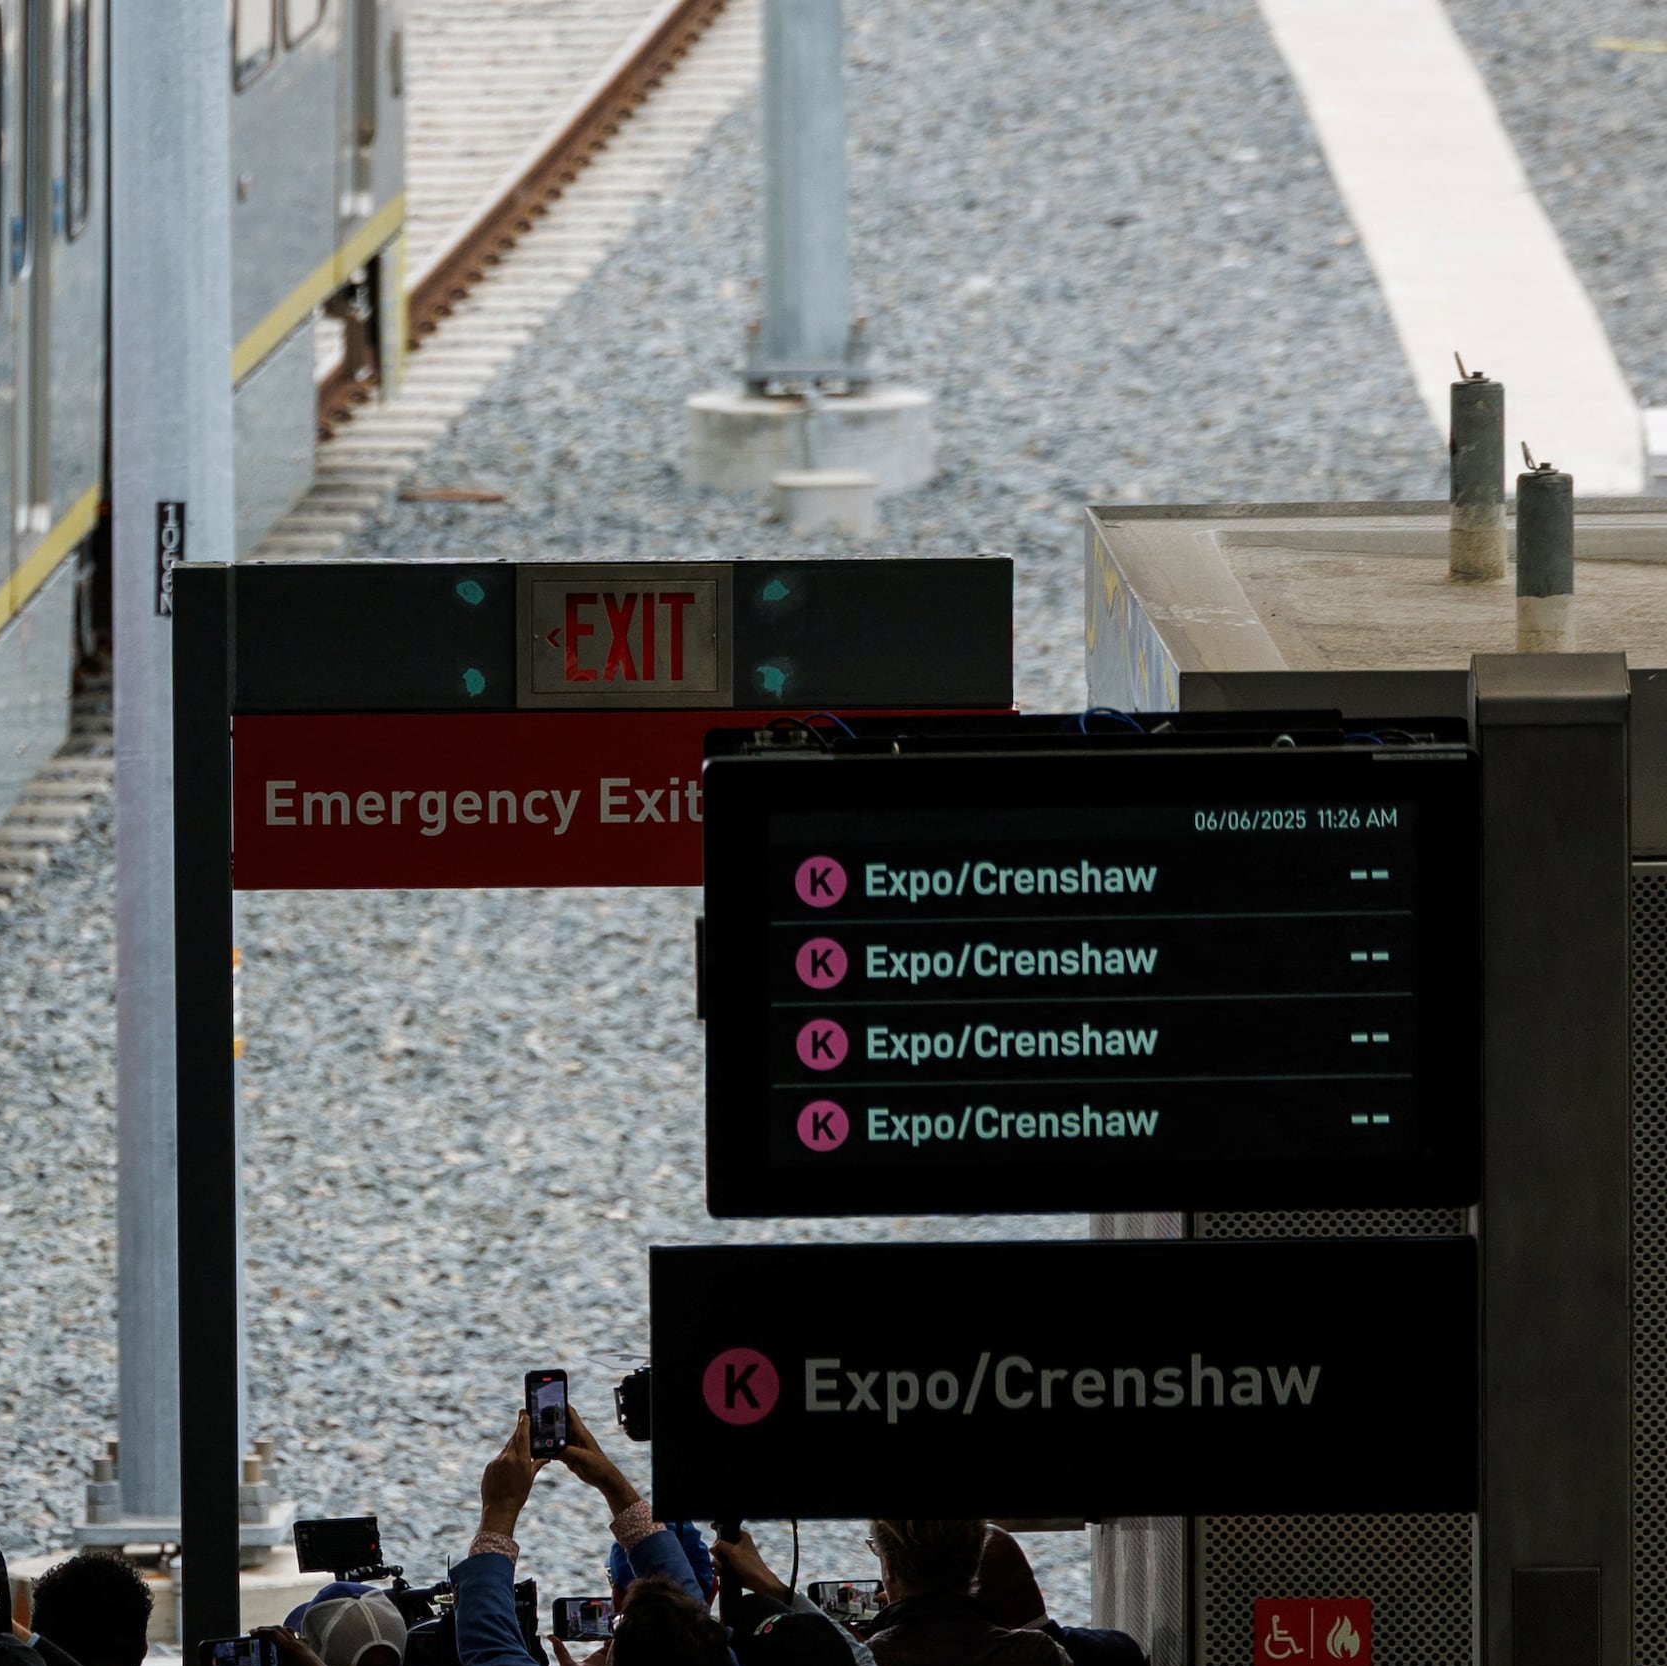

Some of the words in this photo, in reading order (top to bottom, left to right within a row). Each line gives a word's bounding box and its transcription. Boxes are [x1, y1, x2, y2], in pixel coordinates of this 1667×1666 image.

[566, 593, 695, 682] EXIT
[266, 780, 581, 836] Emergency
[600, 777, 704, 824] Exit
[1194, 810, 1307, 831] 06/06/2025
[1317, 809, 1361, 829] 11:26
[1365, 808, 1398, 828] AM
[809, 866, 834, 896] K
[865, 861, 1157, 902] Expo/Crenshaw
[810, 948, 835, 977] K
[866, 942, 1158, 984] Expo/Crenshaw
[811, 1030, 835, 1059] K
[867, 1023, 1158, 1065] Expo/Crenshaw
[811, 1111, 836, 1140] K
[868, 1105, 1159, 1146] Expo/Crenshaw
[725, 1363, 761, 1410] K
[804, 1352, 1321, 1423] Expo/Crenshaw
